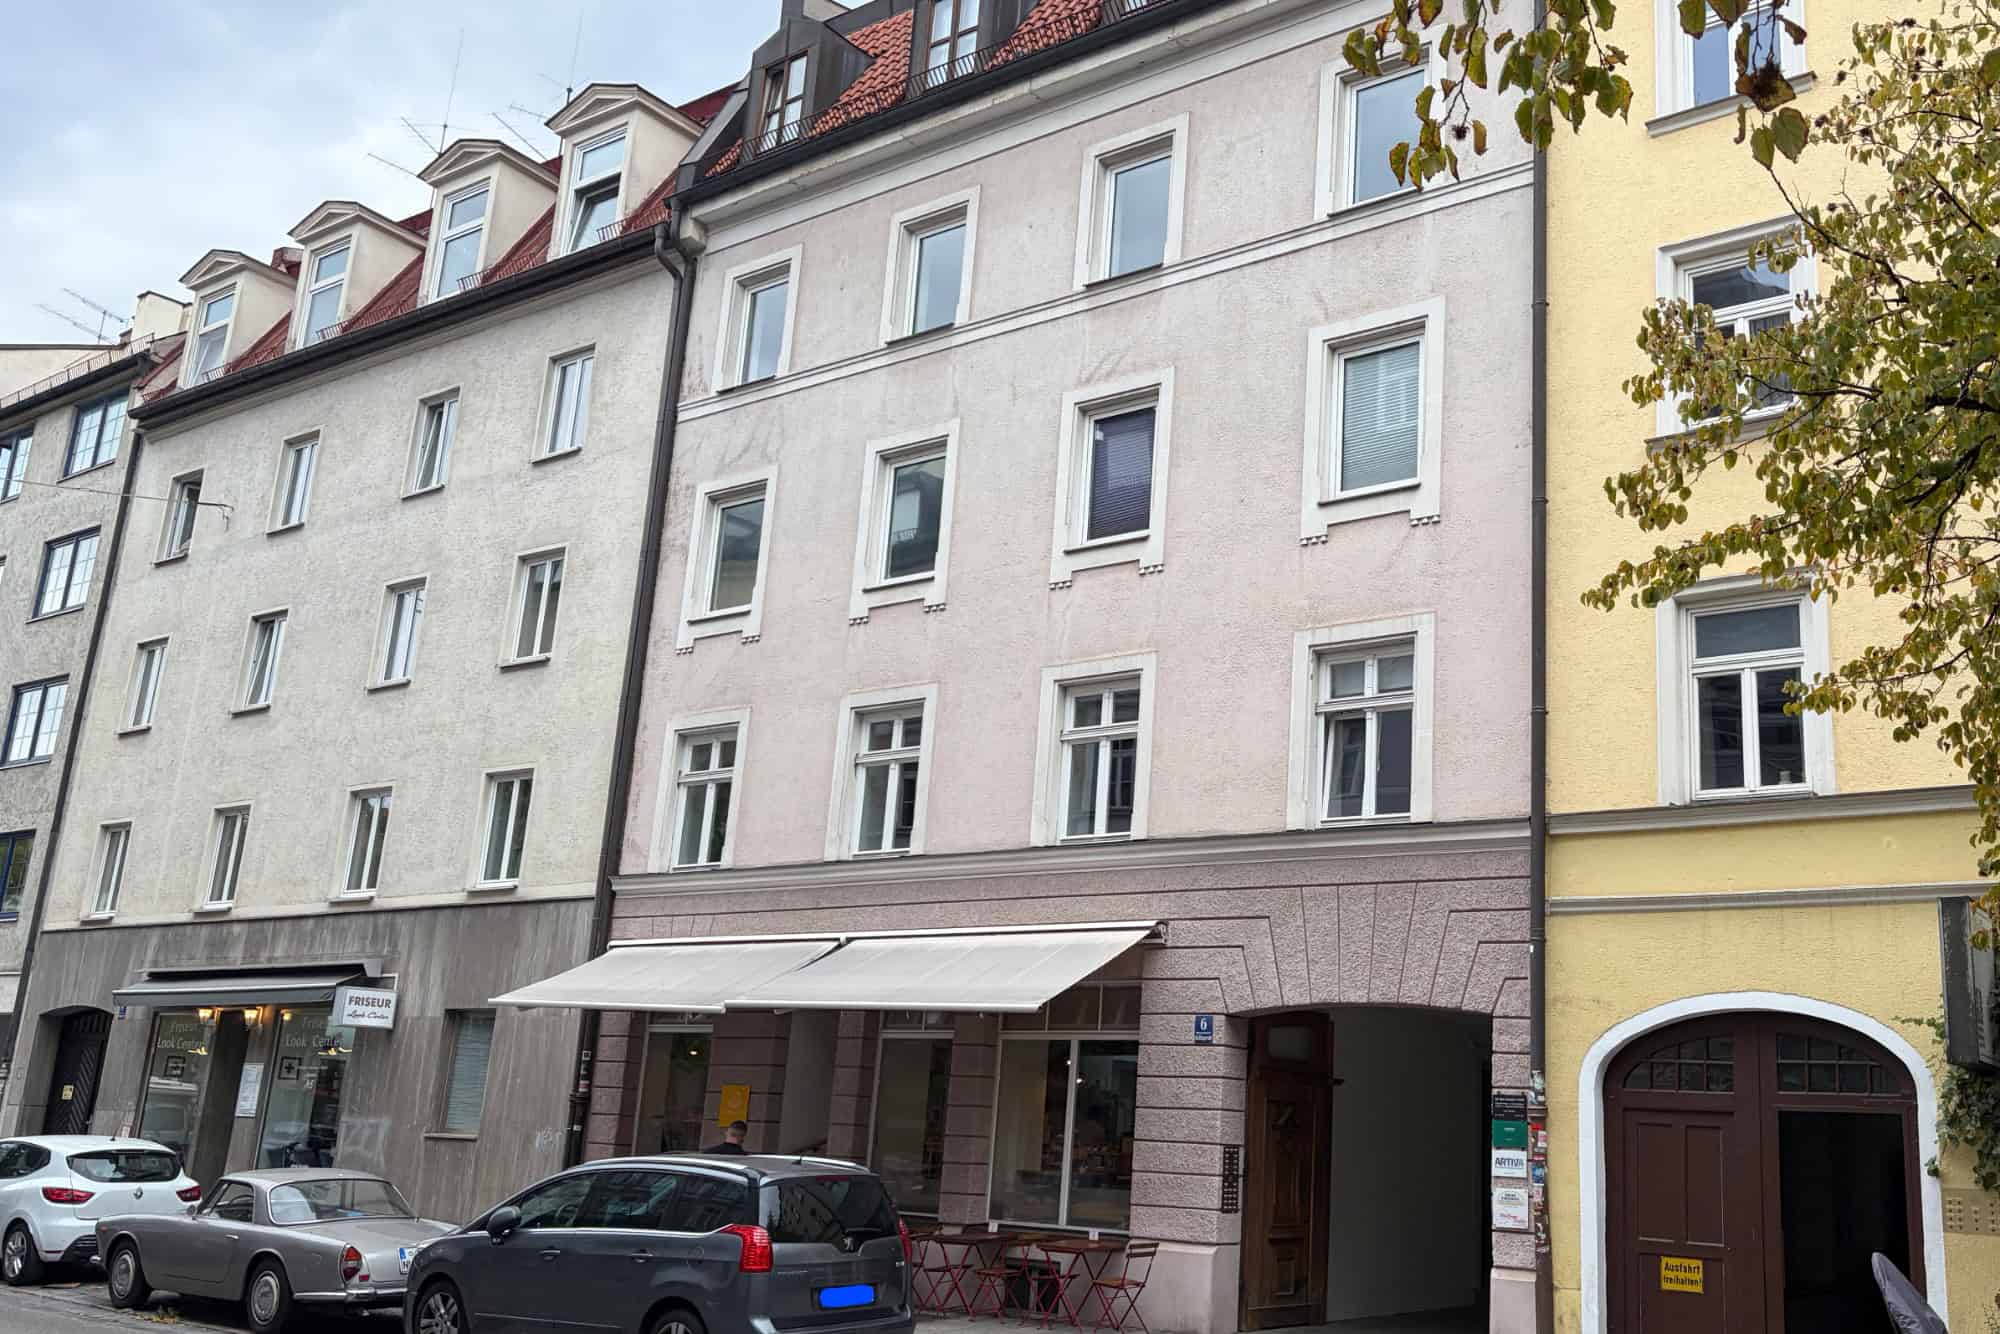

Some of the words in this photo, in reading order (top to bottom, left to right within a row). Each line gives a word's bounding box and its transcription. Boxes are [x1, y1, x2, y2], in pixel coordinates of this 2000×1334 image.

[348, 996, 392, 1009] FRISEUR
[1200, 1017, 1208, 1031] 6
[1664, 1261, 1700, 1275] Ausfahrt
